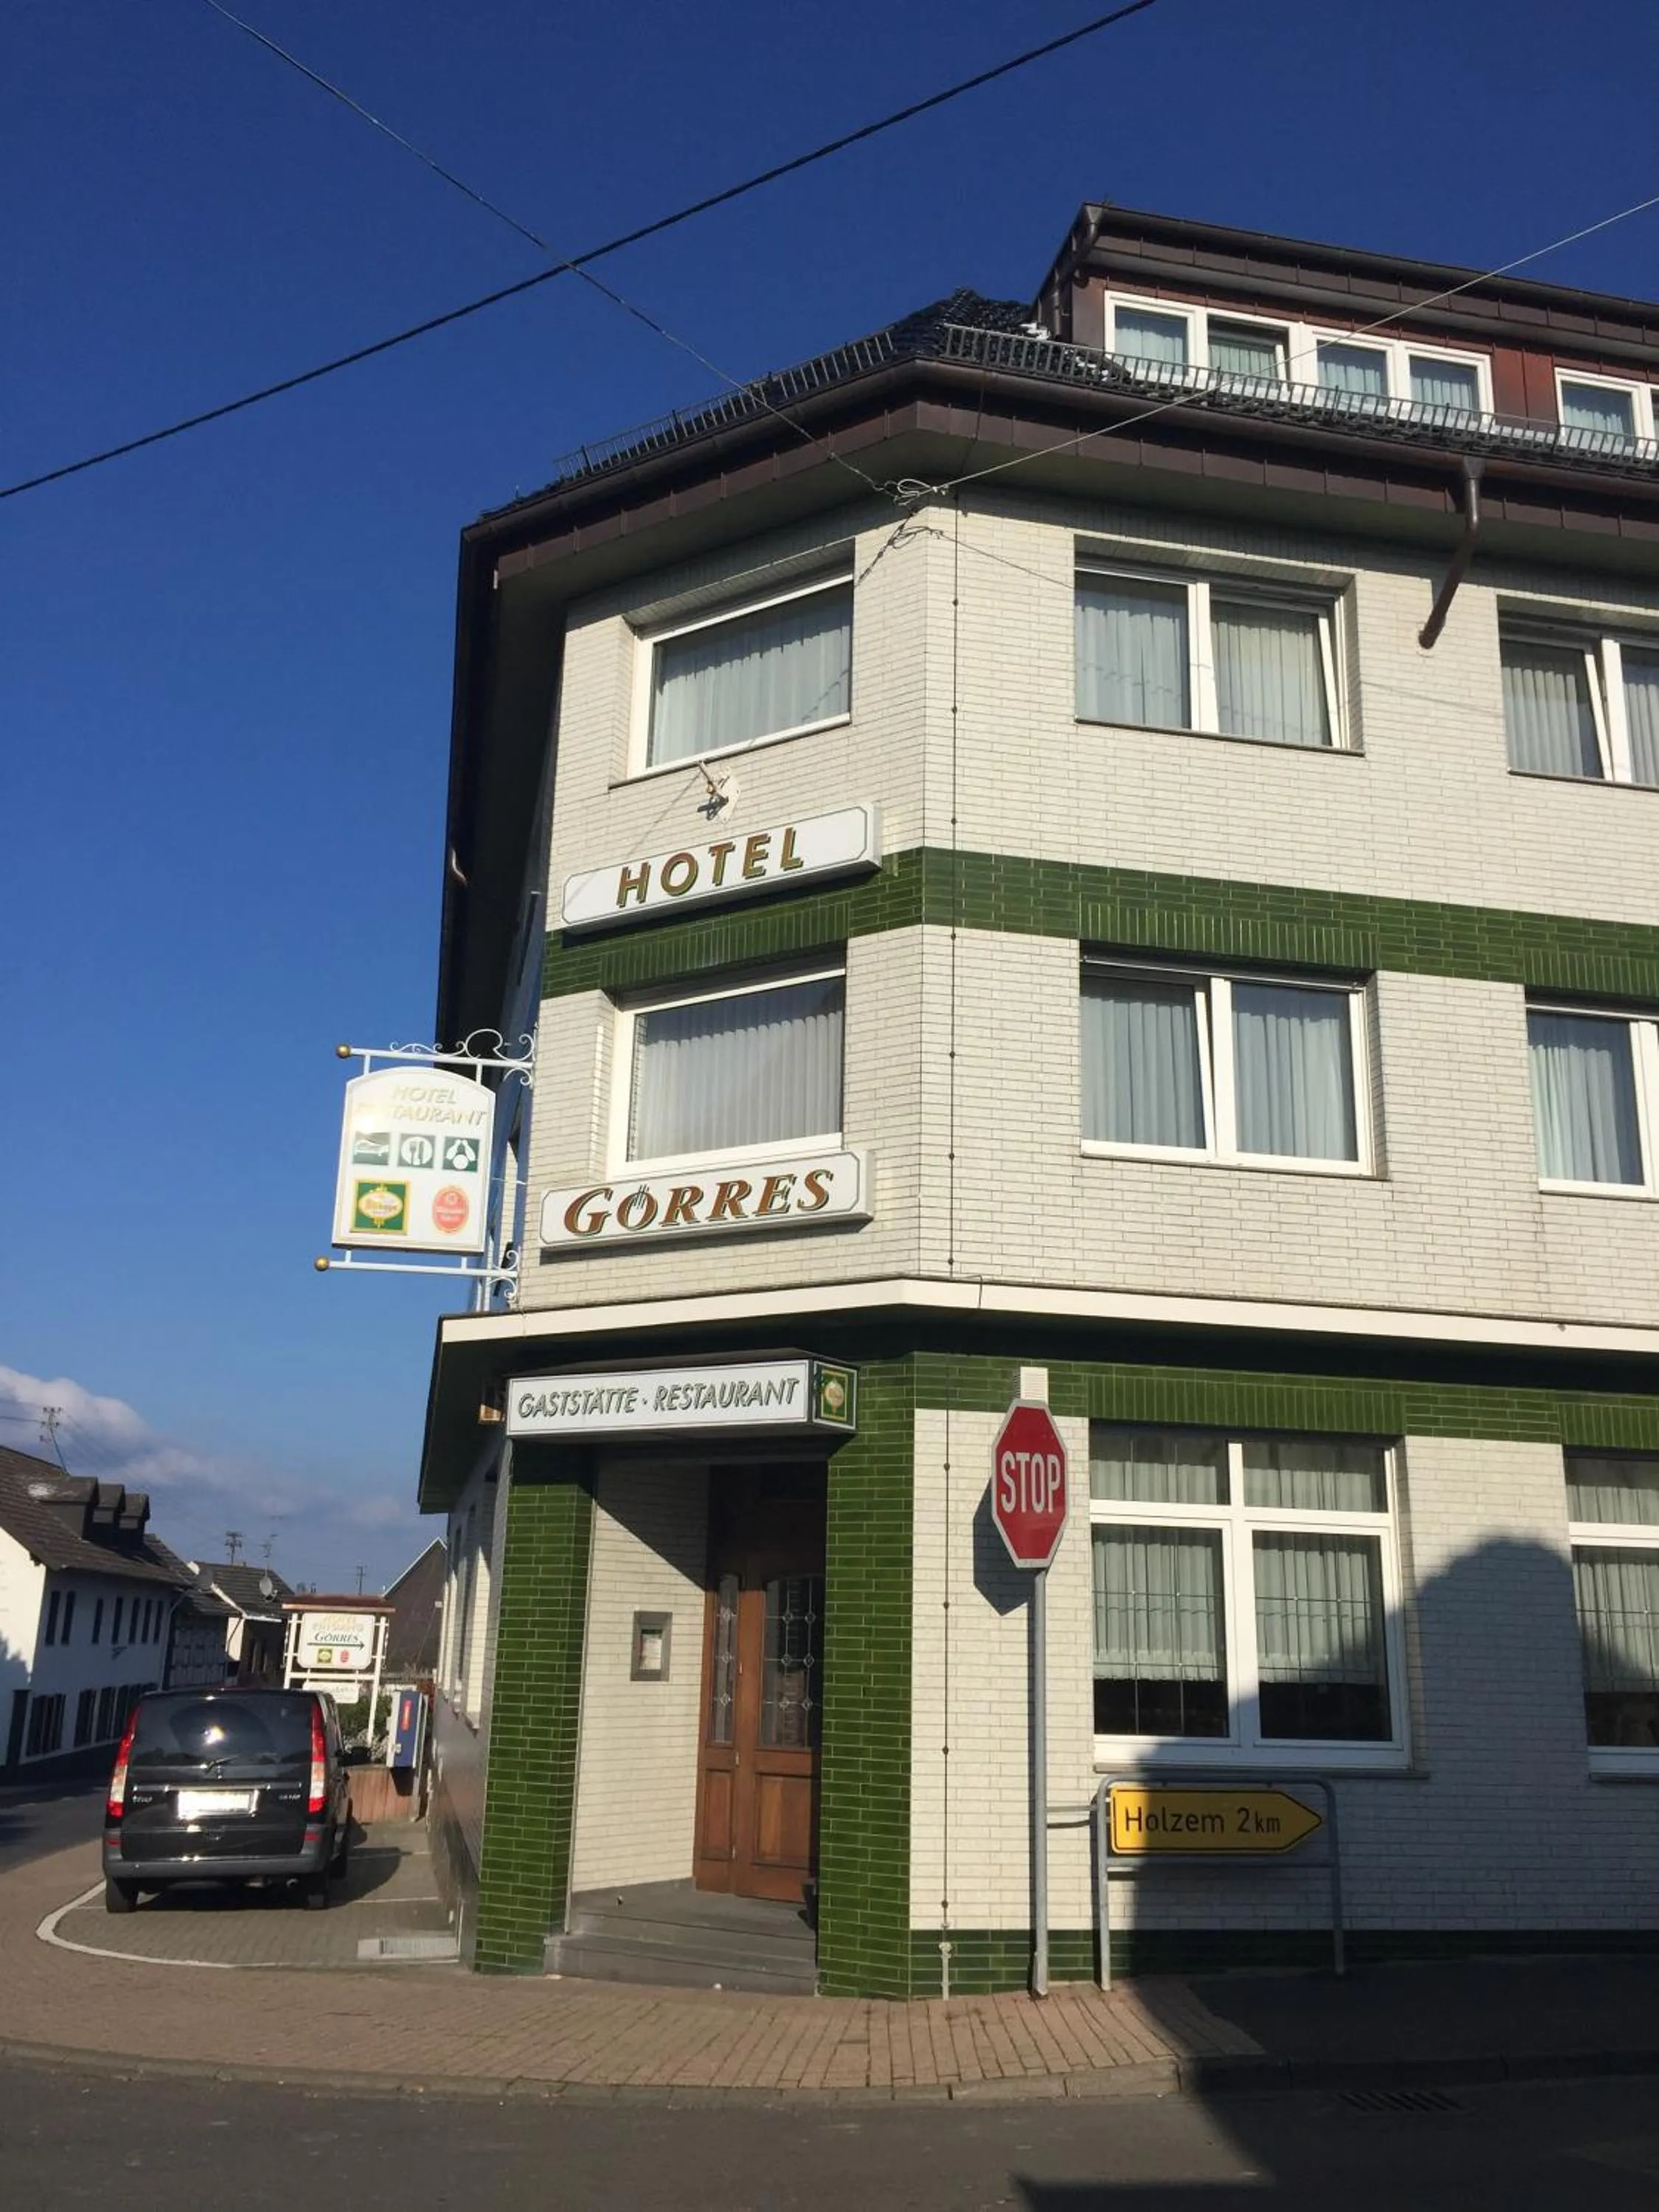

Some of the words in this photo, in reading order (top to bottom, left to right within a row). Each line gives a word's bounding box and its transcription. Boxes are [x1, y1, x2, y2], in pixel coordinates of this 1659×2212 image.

[616, 827, 803, 908] HOTEL
[355, 1102, 487, 1127] TAURANT
[391, 1084, 457, 1105] HOTEL
[563, 1169, 833, 1237] GÖRRES
[518, 1387, 639, 1418] GASTSTÄTTE
[653, 1377, 800, 1411] RESTAURANT
[1001, 1450, 1061, 1514] STOP
[1125, 1806, 1225, 1834] Holzem
